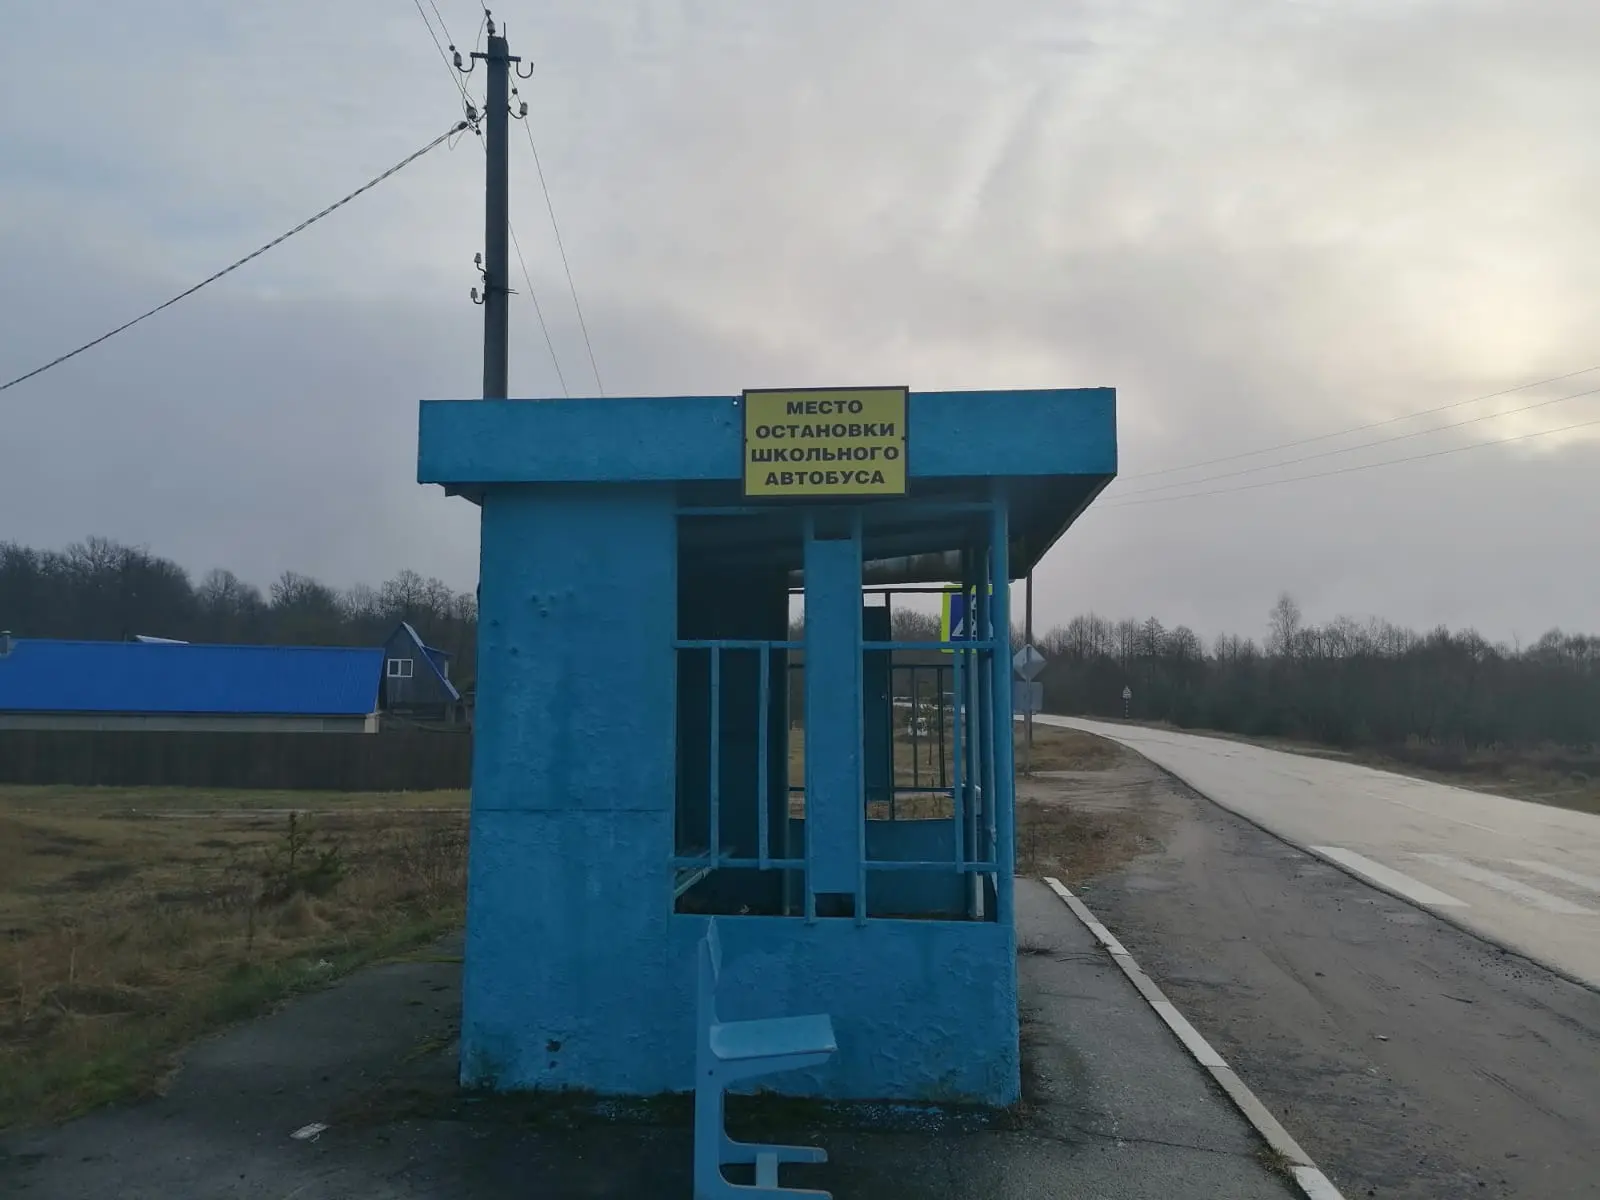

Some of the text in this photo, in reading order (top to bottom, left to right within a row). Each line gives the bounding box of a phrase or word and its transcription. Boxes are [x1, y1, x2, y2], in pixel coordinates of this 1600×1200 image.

[786, 400, 863, 415] МЕСТО
[755, 423, 895, 439] ОСТАНОВКИ
[751, 446, 899, 463] ШКОЛЬНОГО
[764, 470, 885, 486] АВТОБУСА
